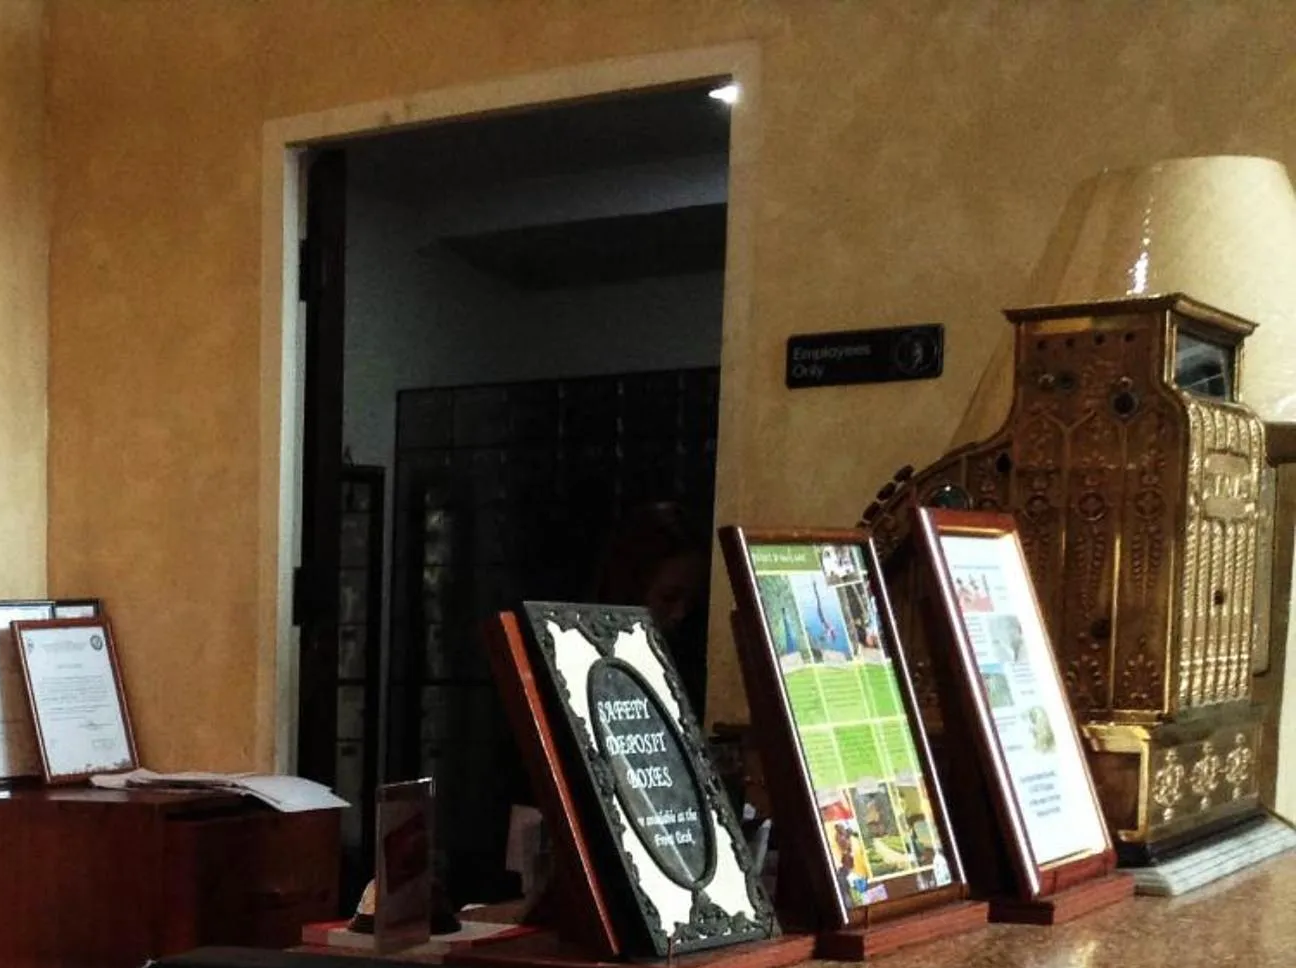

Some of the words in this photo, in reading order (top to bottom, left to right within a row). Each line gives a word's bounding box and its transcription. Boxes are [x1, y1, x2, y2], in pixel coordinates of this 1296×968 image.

[792, 344, 872, 361] Employees
[792, 363, 825, 380] Only
[598, 698, 650, 722] SAFETY
[606, 731, 667, 755] DEPOSIT
[627, 766, 672, 788] BOXES
